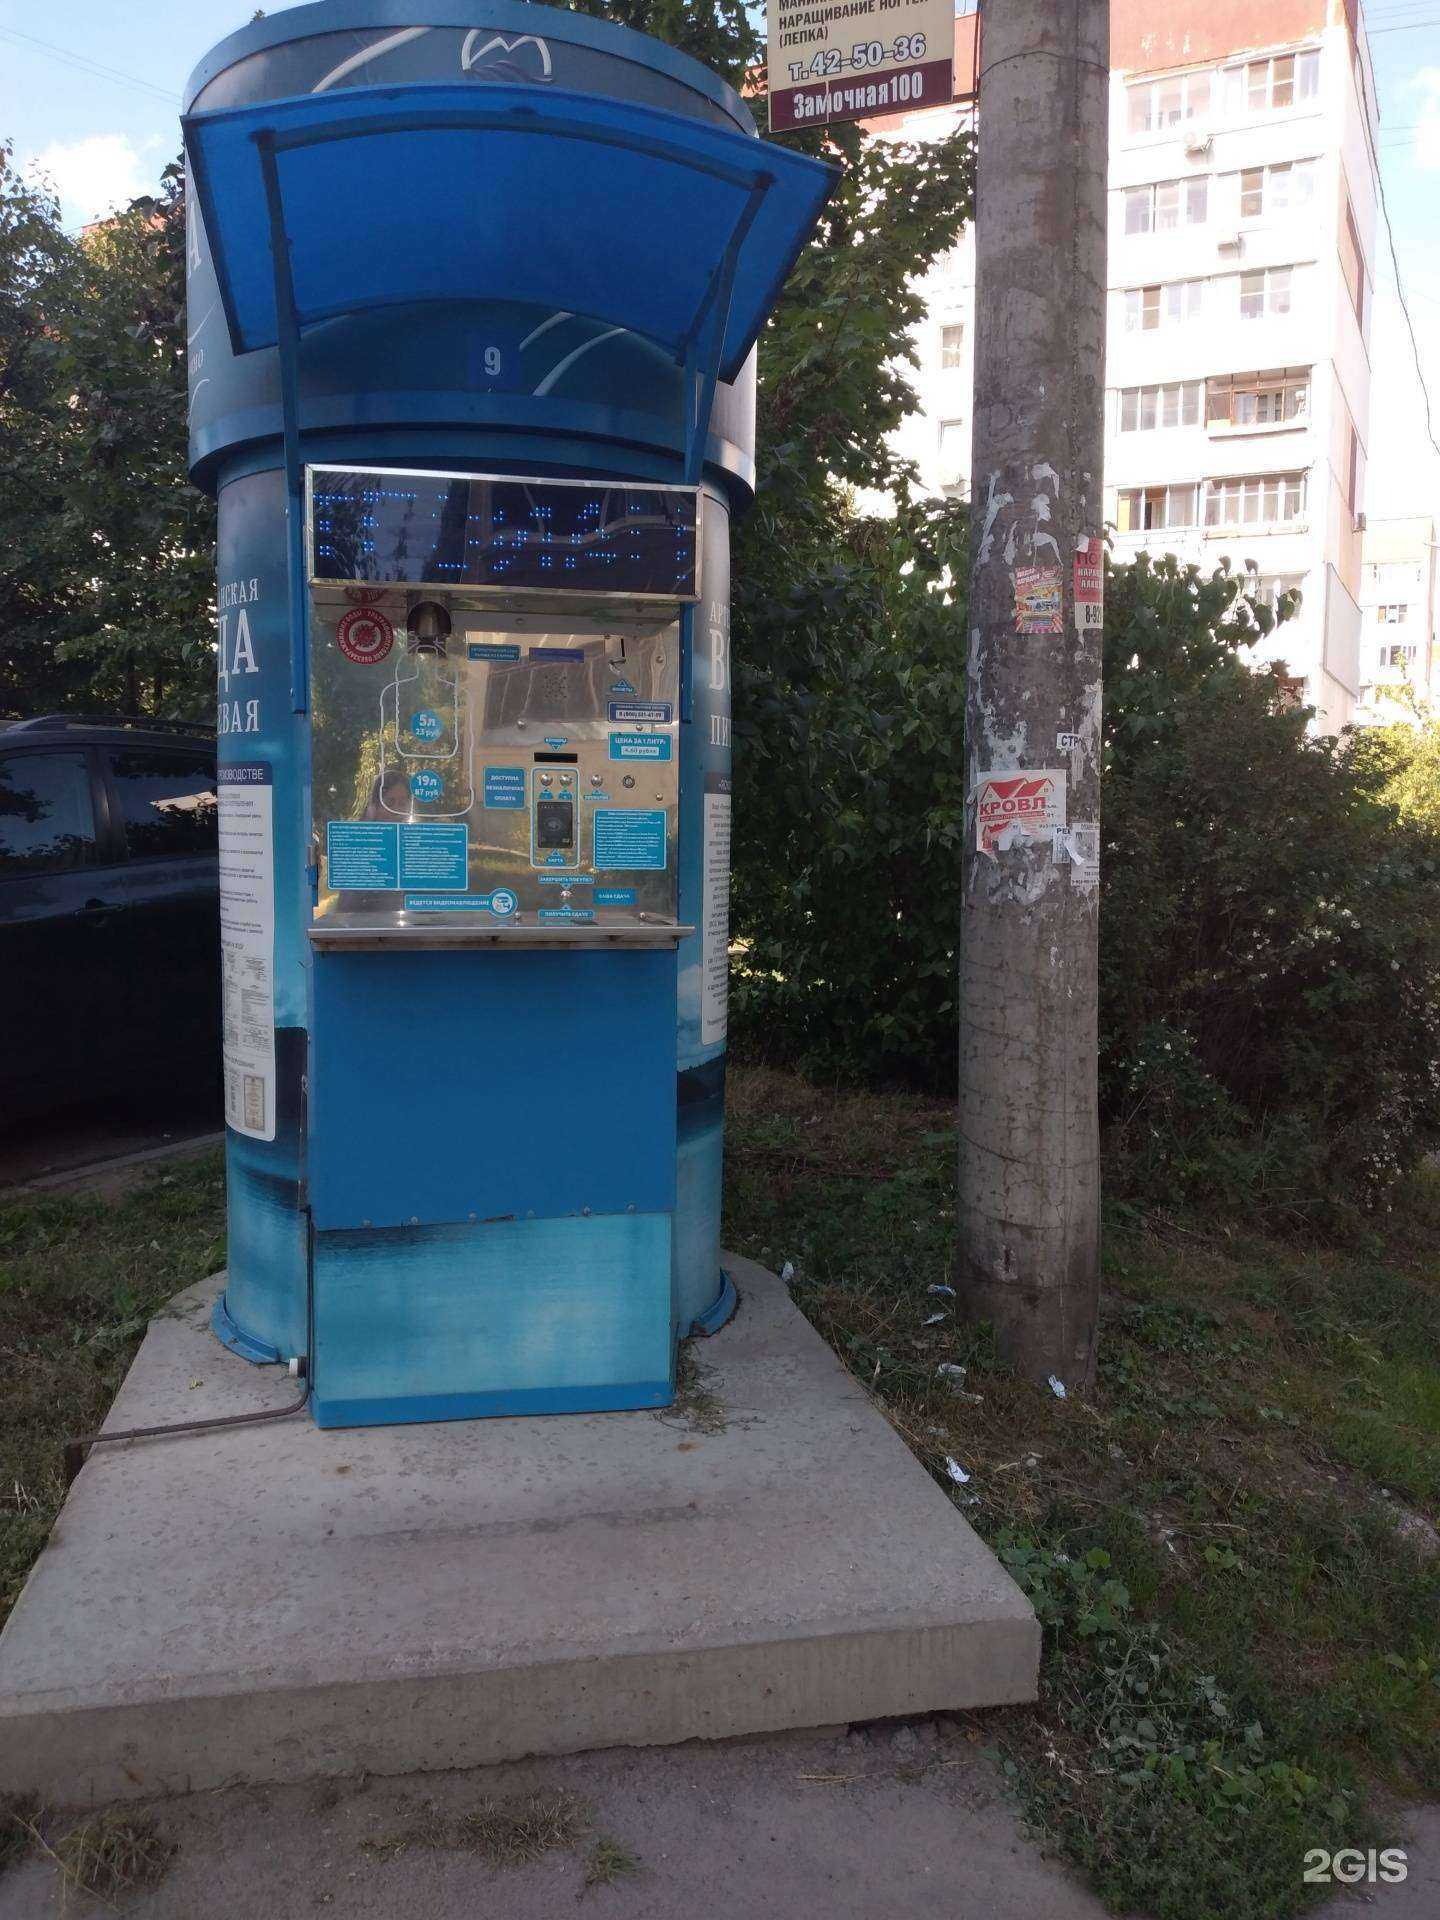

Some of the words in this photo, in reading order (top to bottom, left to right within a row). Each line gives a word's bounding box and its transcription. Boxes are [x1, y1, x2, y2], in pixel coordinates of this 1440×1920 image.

[779, 2, 875, 30] НАРАЩИВАНИЕ
[779, 26, 829, 48] (ЛЕПКА)
[793, 80, 889, 119] Замочная
[891, 71, 923, 102] 100
[484, 346, 501, 376] 9
[416, 775, 437, 786] 19л
